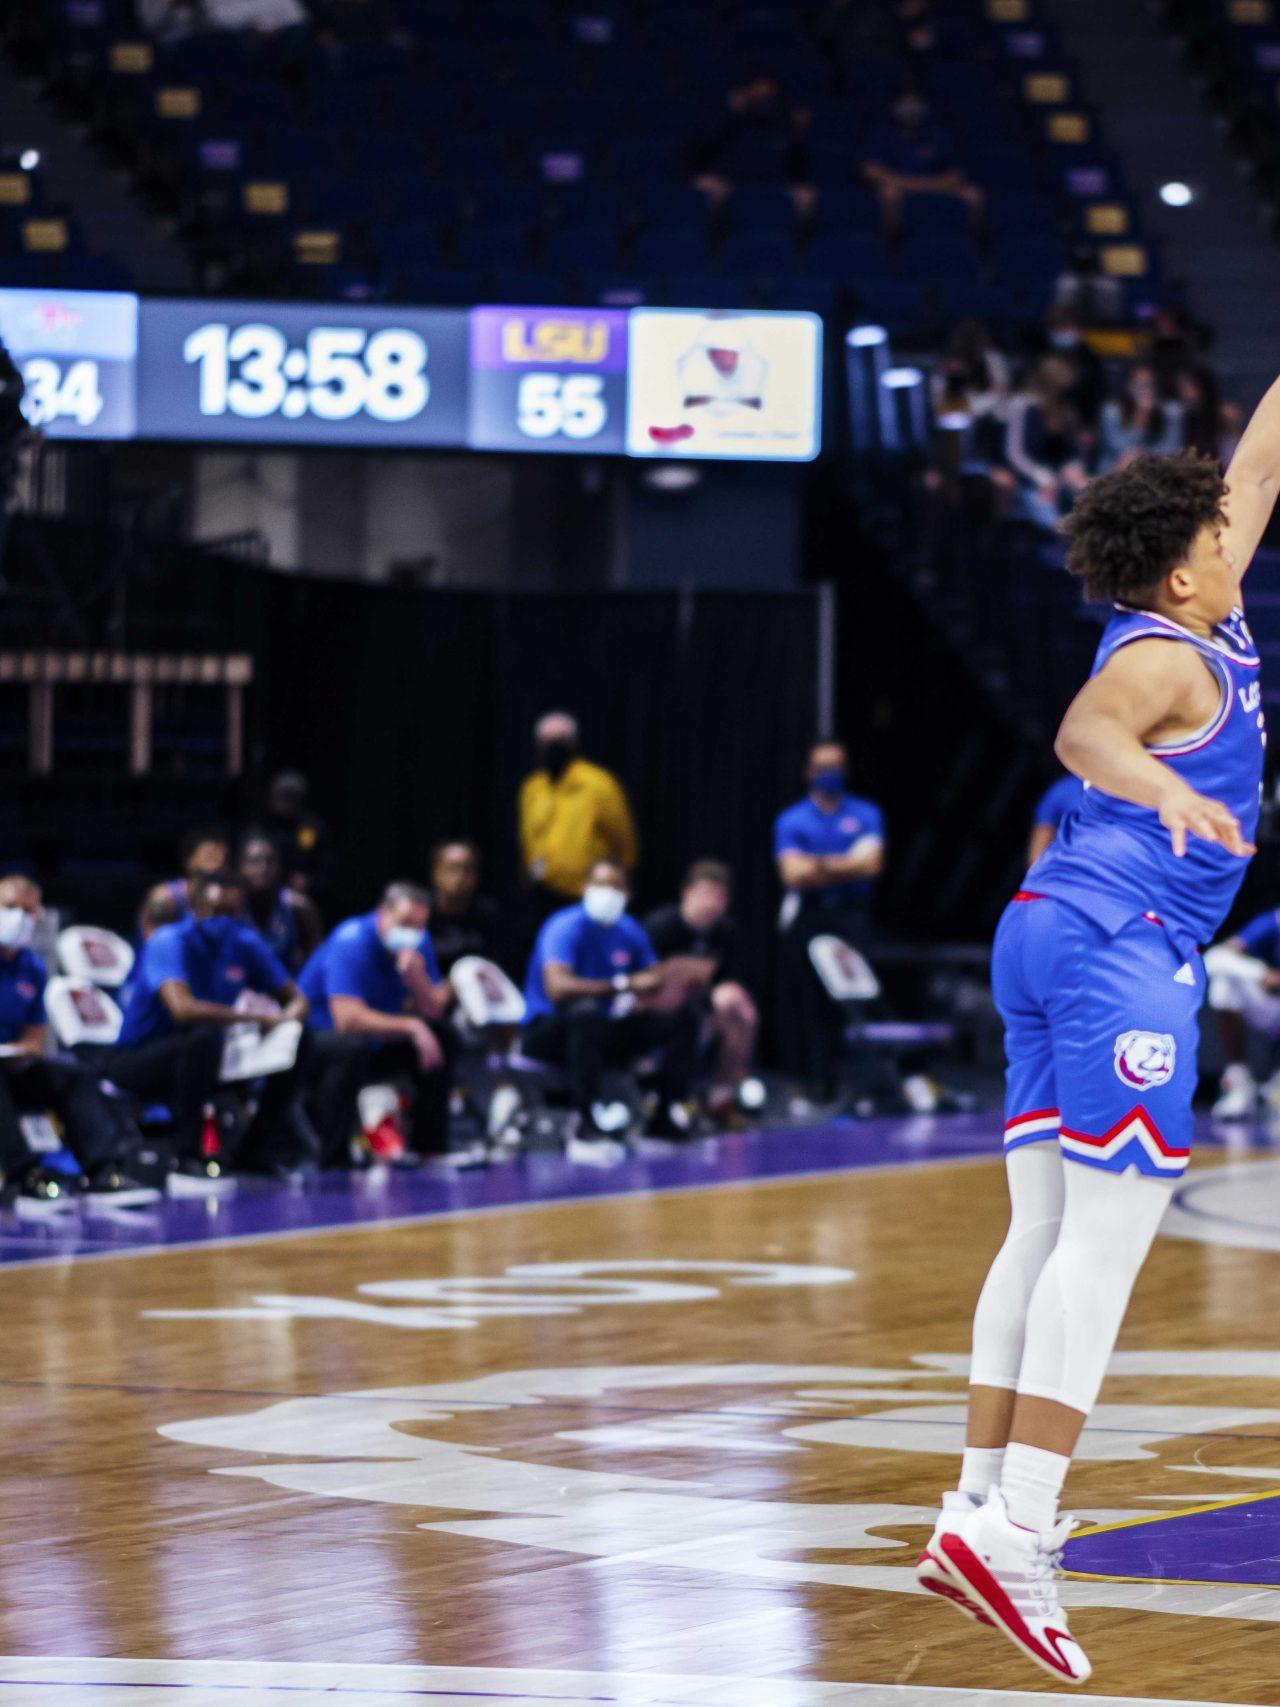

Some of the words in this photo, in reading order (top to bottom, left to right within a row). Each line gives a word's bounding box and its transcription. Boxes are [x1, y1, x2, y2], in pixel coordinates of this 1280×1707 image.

[182, 322, 431, 423] 13:58
[501, 316, 608, 365] LSU
[19, 359, 104, 427] 34
[517, 372, 608, 441] 55
